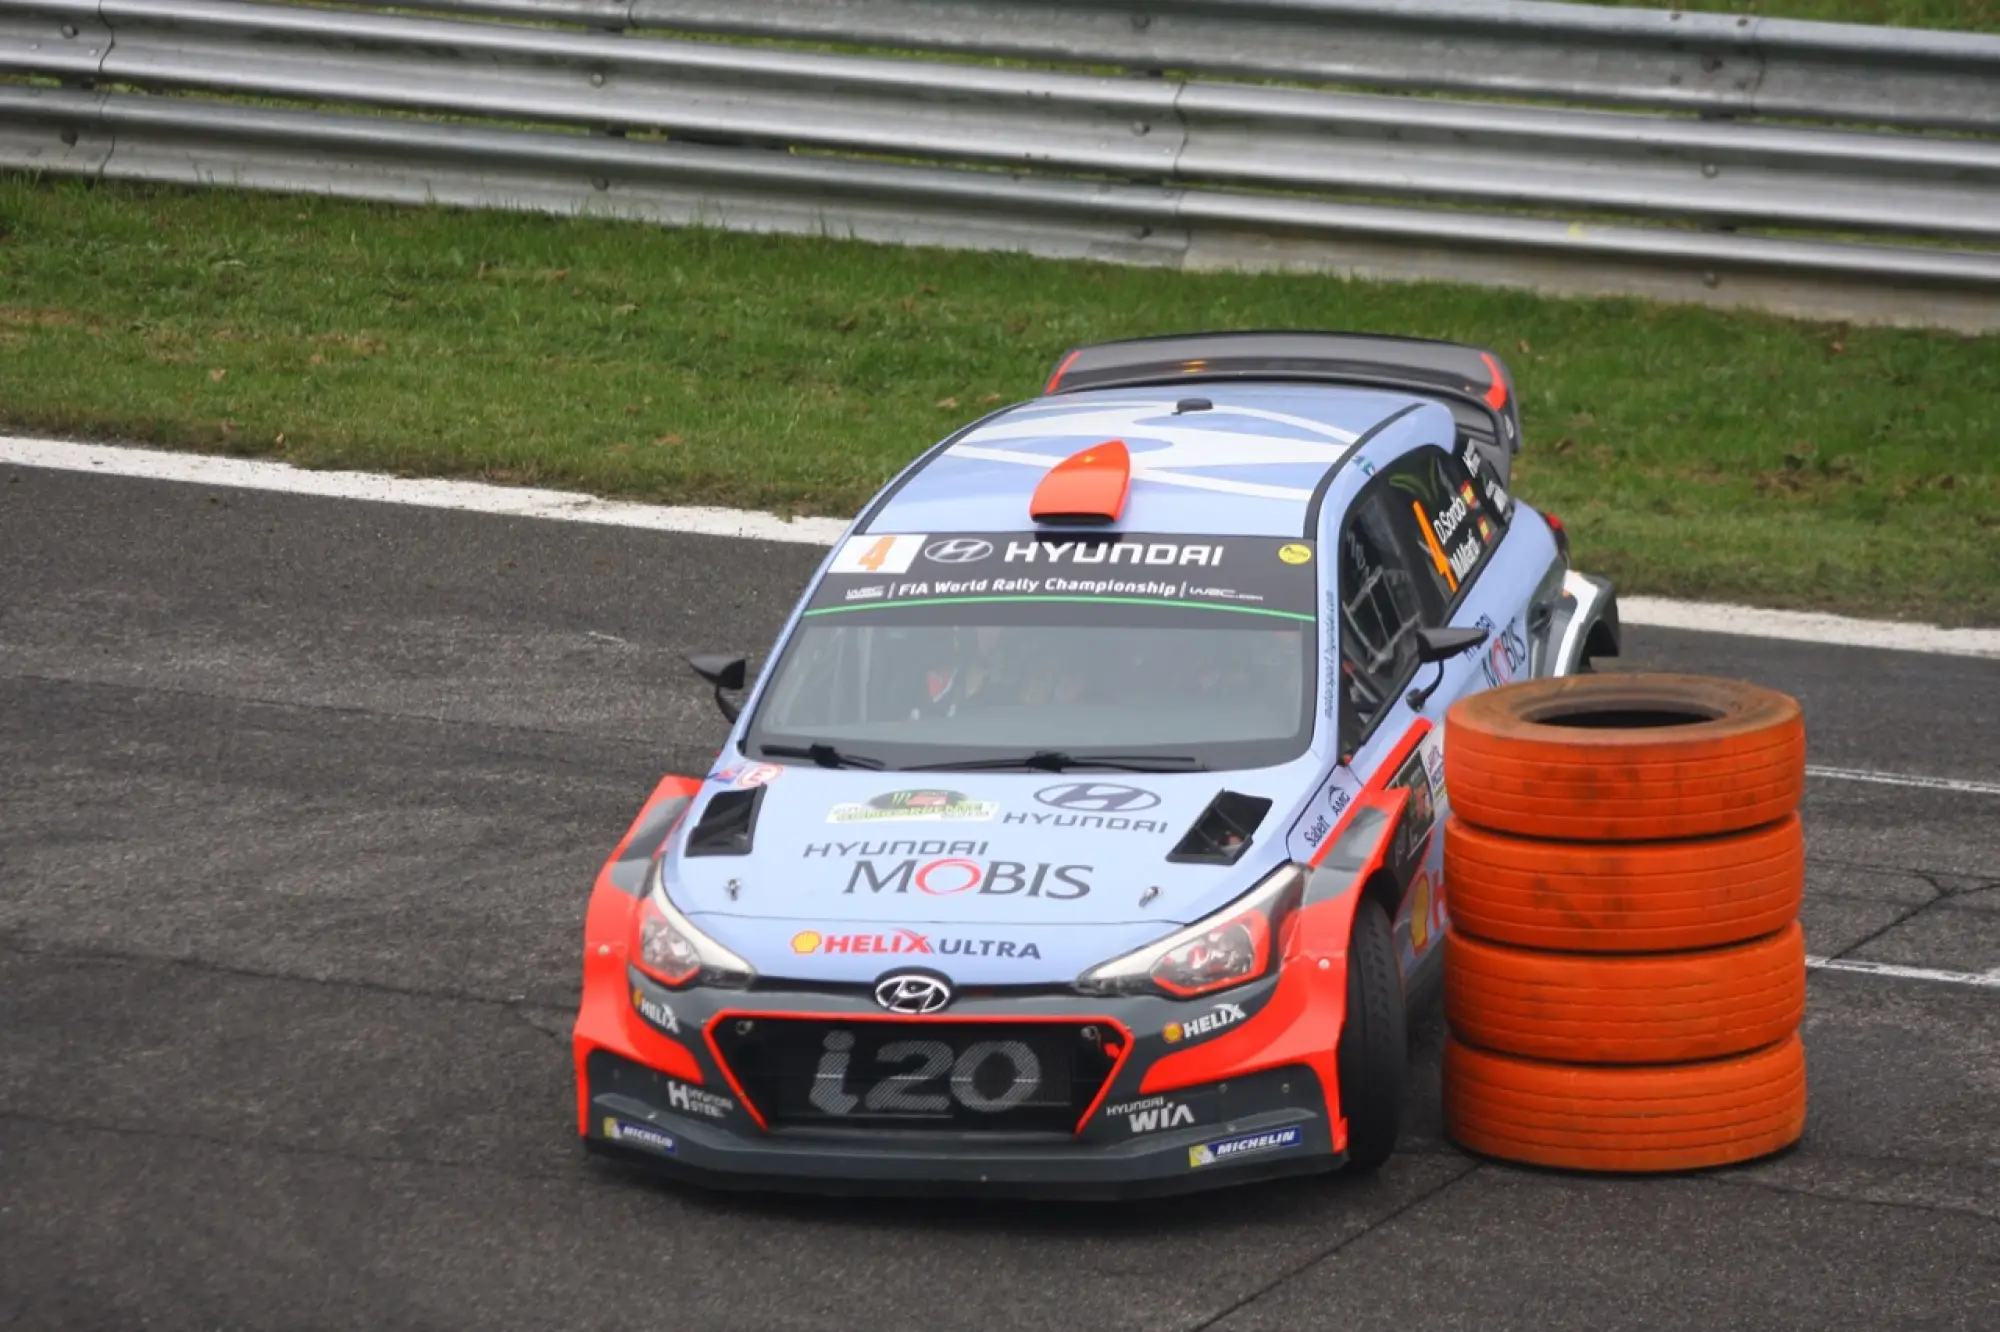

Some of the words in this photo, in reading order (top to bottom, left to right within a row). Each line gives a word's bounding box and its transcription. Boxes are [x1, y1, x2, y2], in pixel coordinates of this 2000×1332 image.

[857, 536, 890, 572] 4
[1004, 541, 1223, 566] HYUNDAI
[898, 580, 929, 596] FIA
[935, 577, 988, 594] World
[992, 576, 1041, 595] Rally
[1045, 577, 1177, 598] Championship
[1003, 811, 1169, 834] HYUNDAI
[802, 839, 990, 858] HYUNDAI
[842, 857, 1096, 900] MOBIS
[824, 928, 936, 955] HELIX
[938, 936, 1042, 960] ULTRA
[641, 999, 681, 1034] HELIX
[1182, 1003, 1247, 1039] HELIX
[809, 1030, 1041, 1115] i20
[1106, 1096, 1164, 1117] HYUNDAI
[622, 1125, 674, 1148] MICHELIN
[1216, 1131, 1296, 1156] MICHELIN
